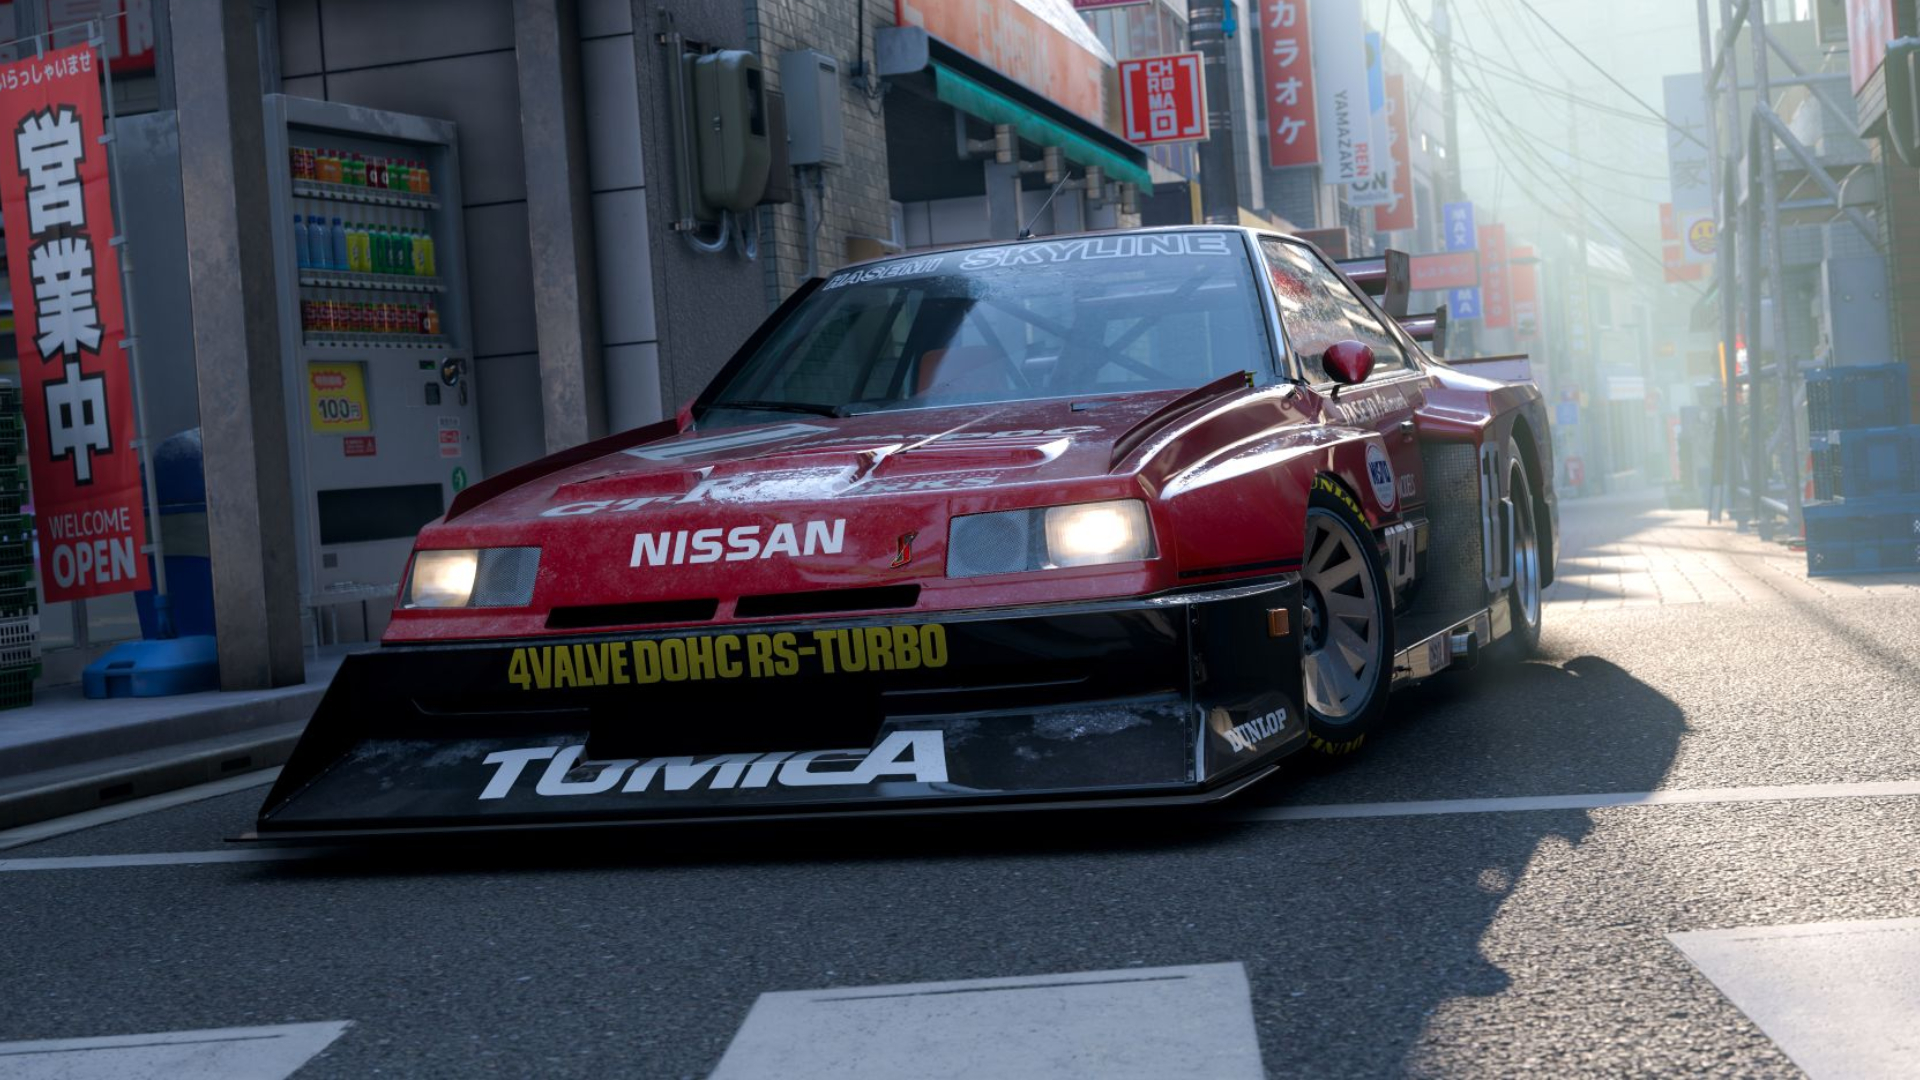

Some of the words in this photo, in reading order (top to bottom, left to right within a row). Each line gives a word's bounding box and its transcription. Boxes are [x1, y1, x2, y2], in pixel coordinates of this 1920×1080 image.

[1269, 0, 1306, 145] カラオケ
[1334, 89, 1353, 179] YAMAZAKI
[822, 257, 944, 292] HASEMI
[959, 232, 1231, 271] SKYLINE
[14, 103, 113, 486] 営業中
[48, 507, 131, 539] WELCOME
[630, 518, 846, 568] NISSAN
[52, 536, 137, 589] OPEN
[633, 634, 743, 685] DOHC
[747, 623, 949, 678] RS-TURBO
[1223, 707, 1288, 753] DUNLOP
[478, 729, 950, 801] TOMICA
